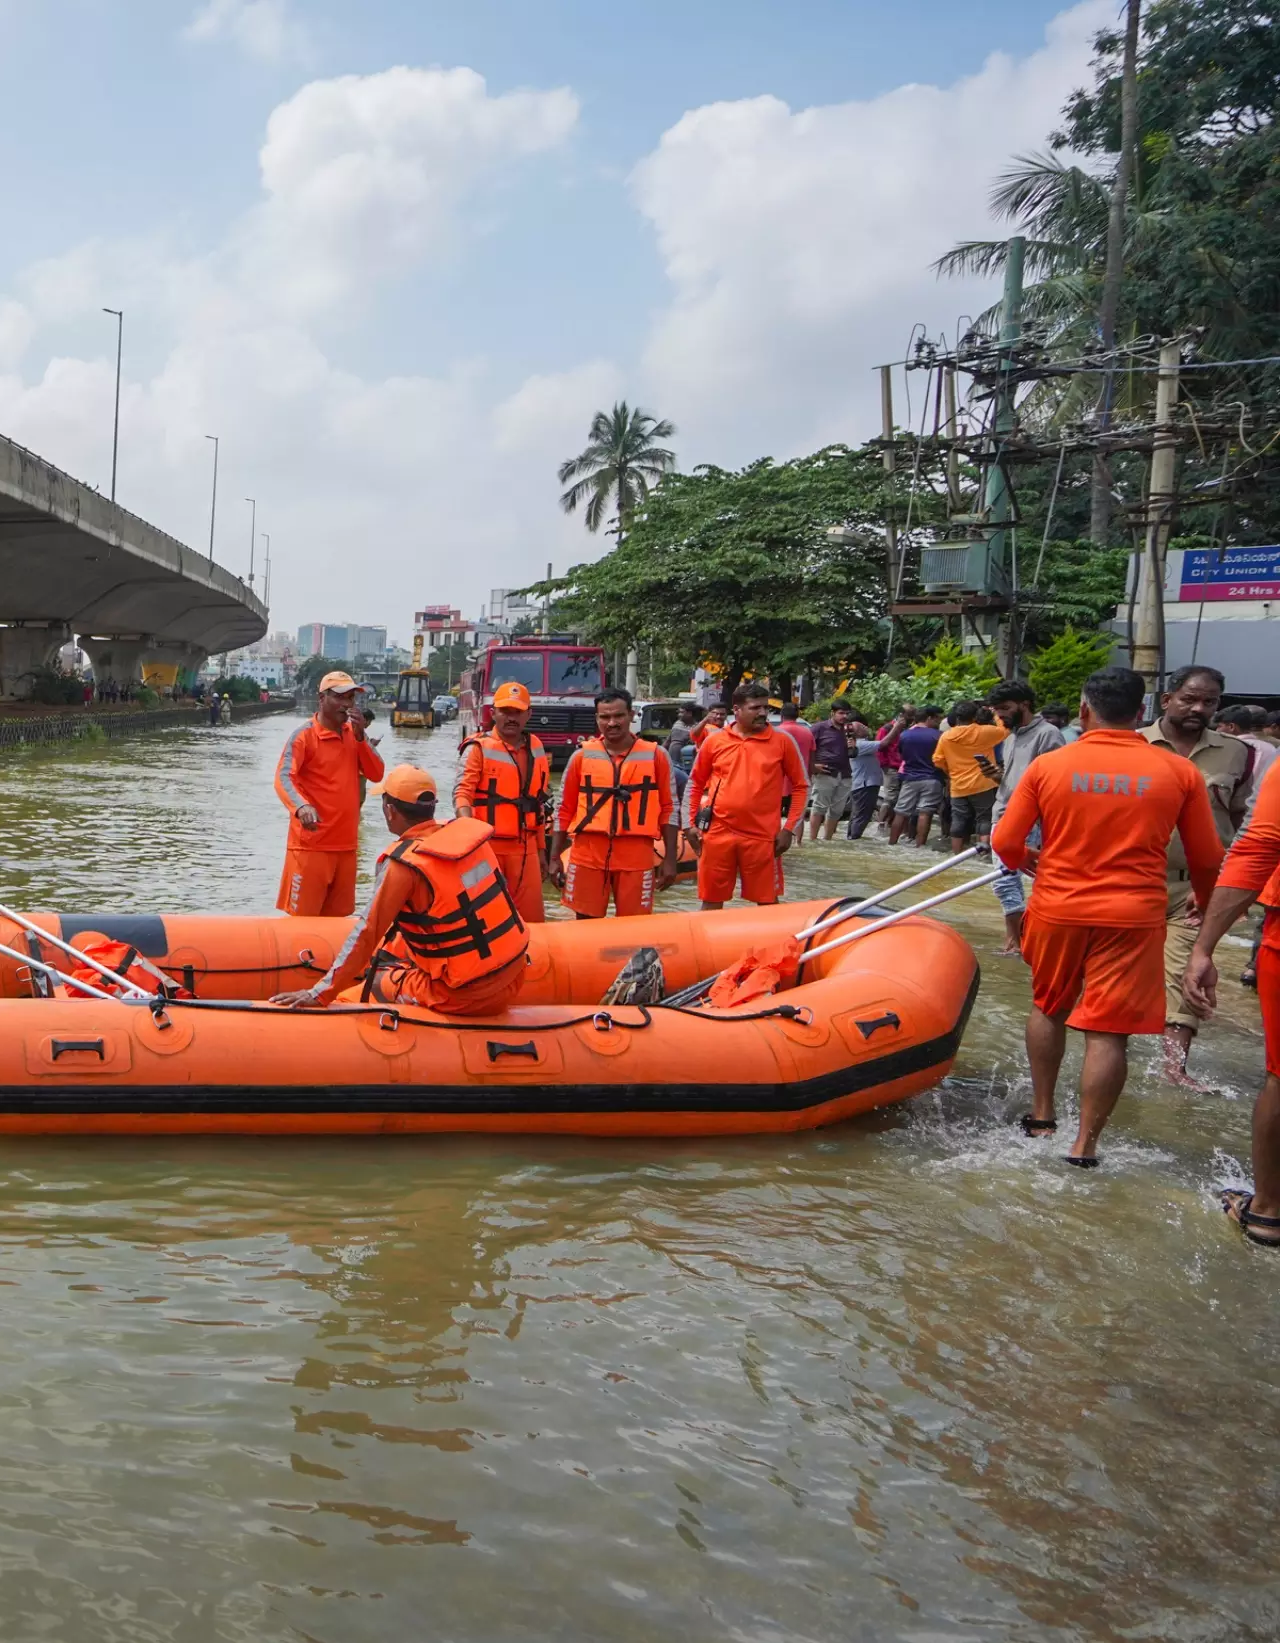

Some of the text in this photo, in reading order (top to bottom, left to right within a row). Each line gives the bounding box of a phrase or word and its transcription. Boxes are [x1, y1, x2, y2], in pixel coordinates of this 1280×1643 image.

[1224, 567, 1268, 576] UNION
[1228, 586, 1246, 596] 24
[1248, 585, 1274, 595] Hrs
[1071, 771, 1153, 797] NDRF
[564, 863, 577, 902] NDRF
[640, 869, 653, 908] NDRF
